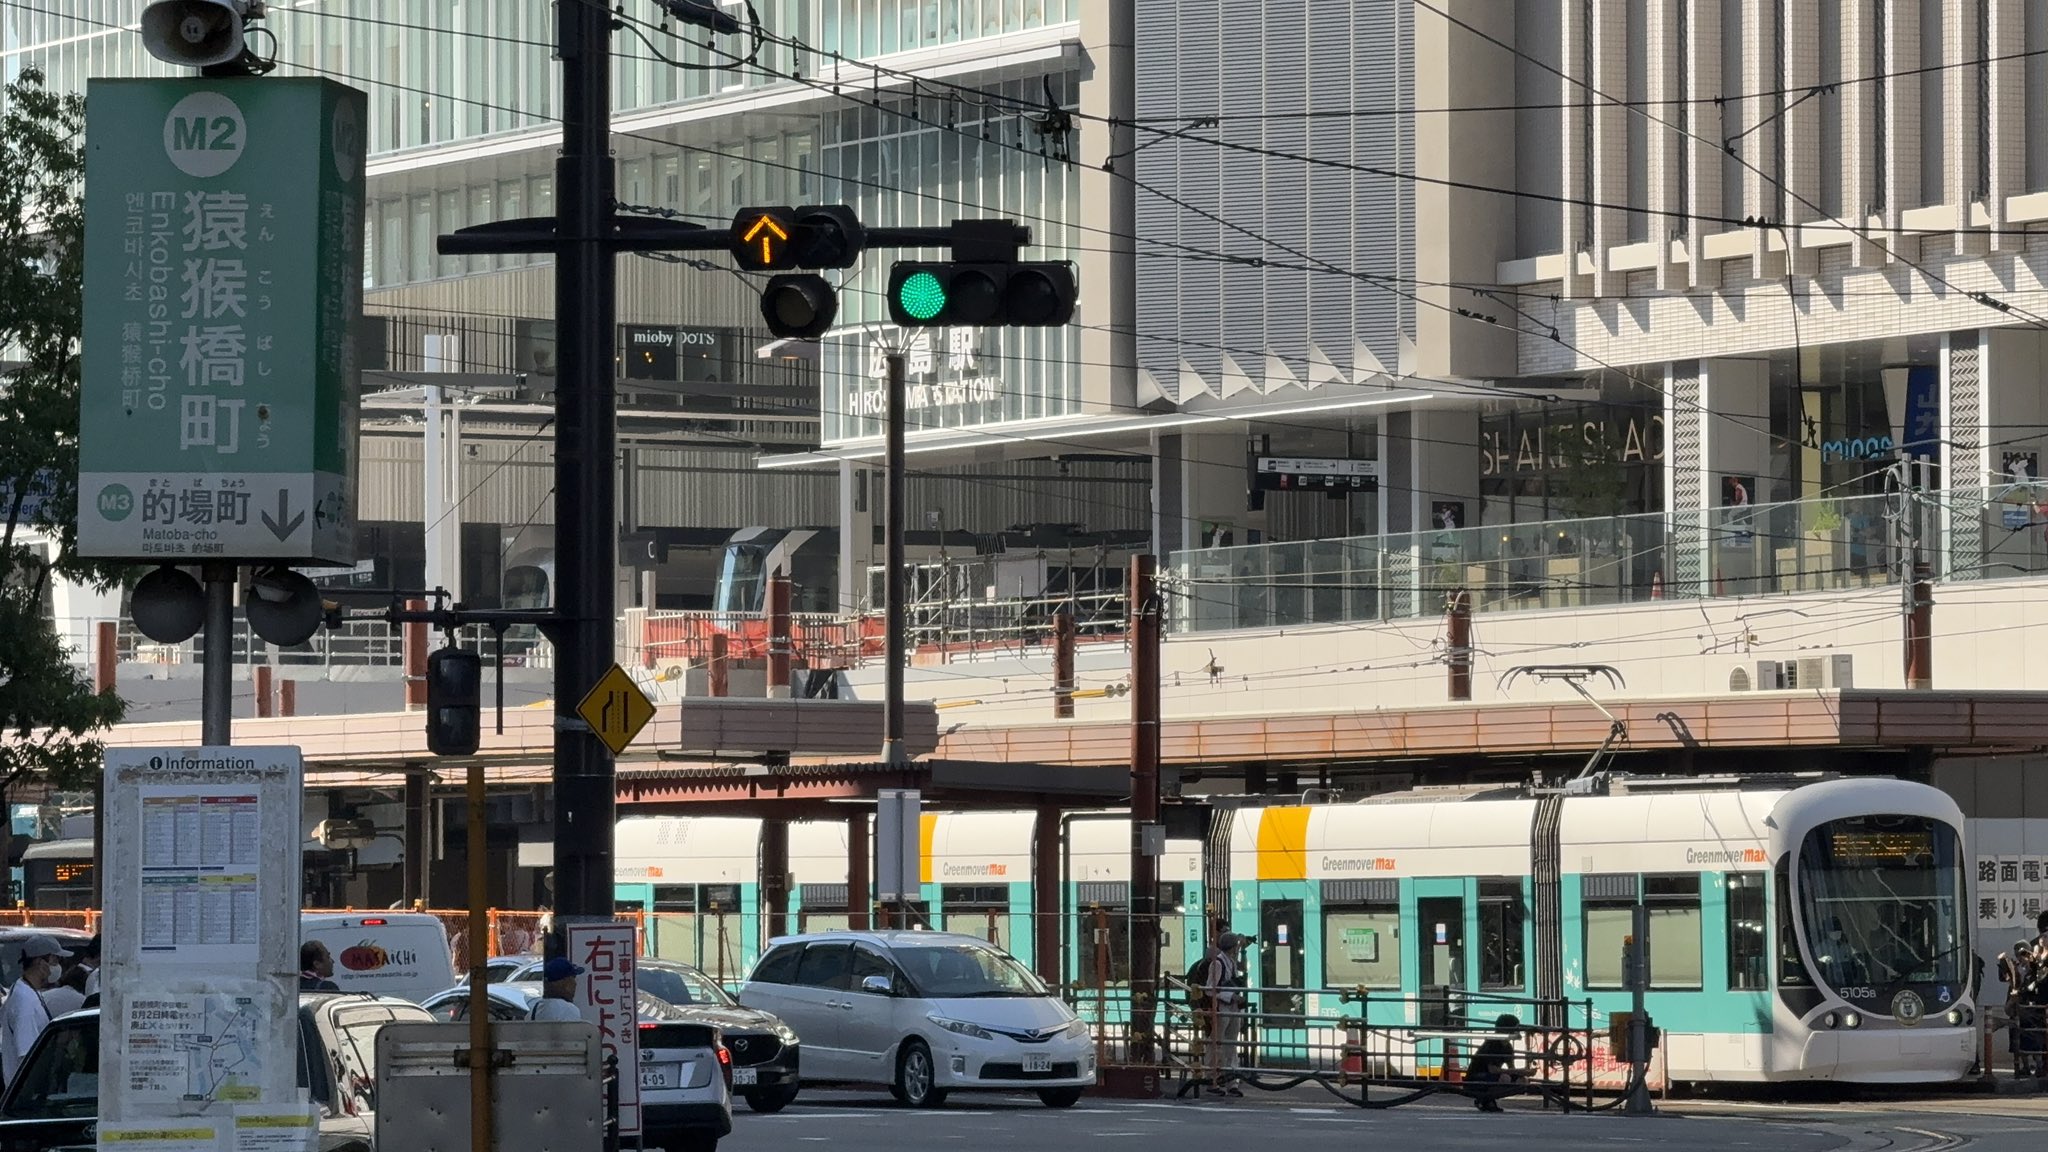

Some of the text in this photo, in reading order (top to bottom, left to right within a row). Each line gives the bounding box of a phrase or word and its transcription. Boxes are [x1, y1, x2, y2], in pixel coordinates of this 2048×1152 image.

[173, 117, 237, 151] M2
[148, 191, 176, 410] Enkobashi-cho
[180, 190, 249, 454] 猿猴橋町
[634, 329, 673, 347] mioby
[932, 376, 995, 407] STATION
[101, 493, 130, 511] M3
[142, 488, 251, 526] 的場町
[143, 527, 217, 541] Matoba-cho
[166, 756, 255, 770] Information
[1321, 856, 1396, 872] Greenmovermax
[1686, 847, 1767, 865] Greenmovermax
[942, 861, 1008, 877] Greenmovermax
[1979, 898, 2041, 920] 乗り場
[618, 939, 633, 1045] 工事中につき
